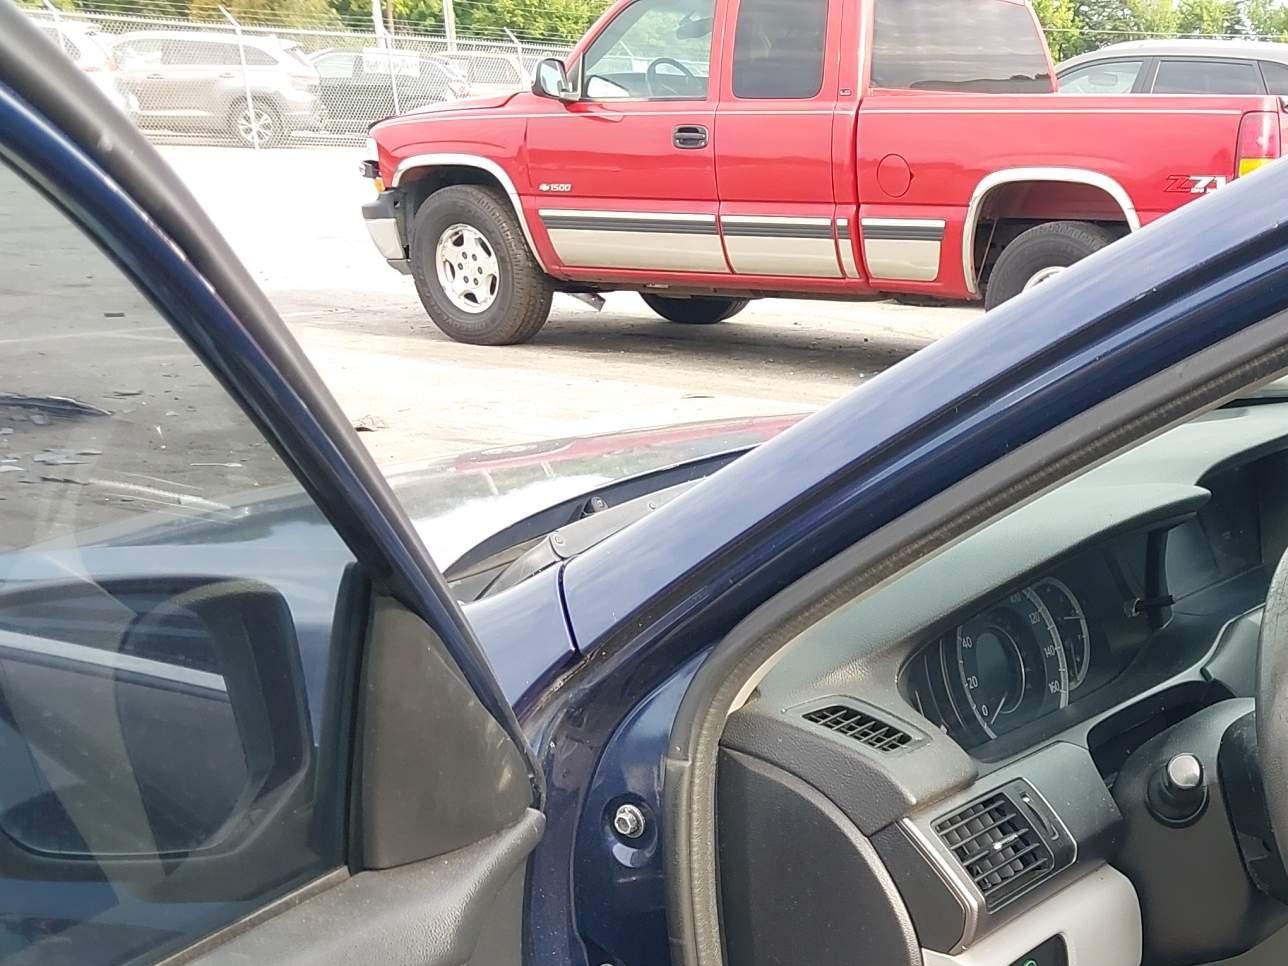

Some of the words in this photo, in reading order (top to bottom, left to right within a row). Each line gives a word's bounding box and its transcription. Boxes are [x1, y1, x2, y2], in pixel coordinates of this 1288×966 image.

[550, 183, 572, 191] 1500
[1164, 175, 1227, 194] Z71
[962, 636, 973, 648] 40
[1044, 645, 1056, 658] 140
[967, 675, 978, 689] 20
[981, 704, 989, 717] 0
